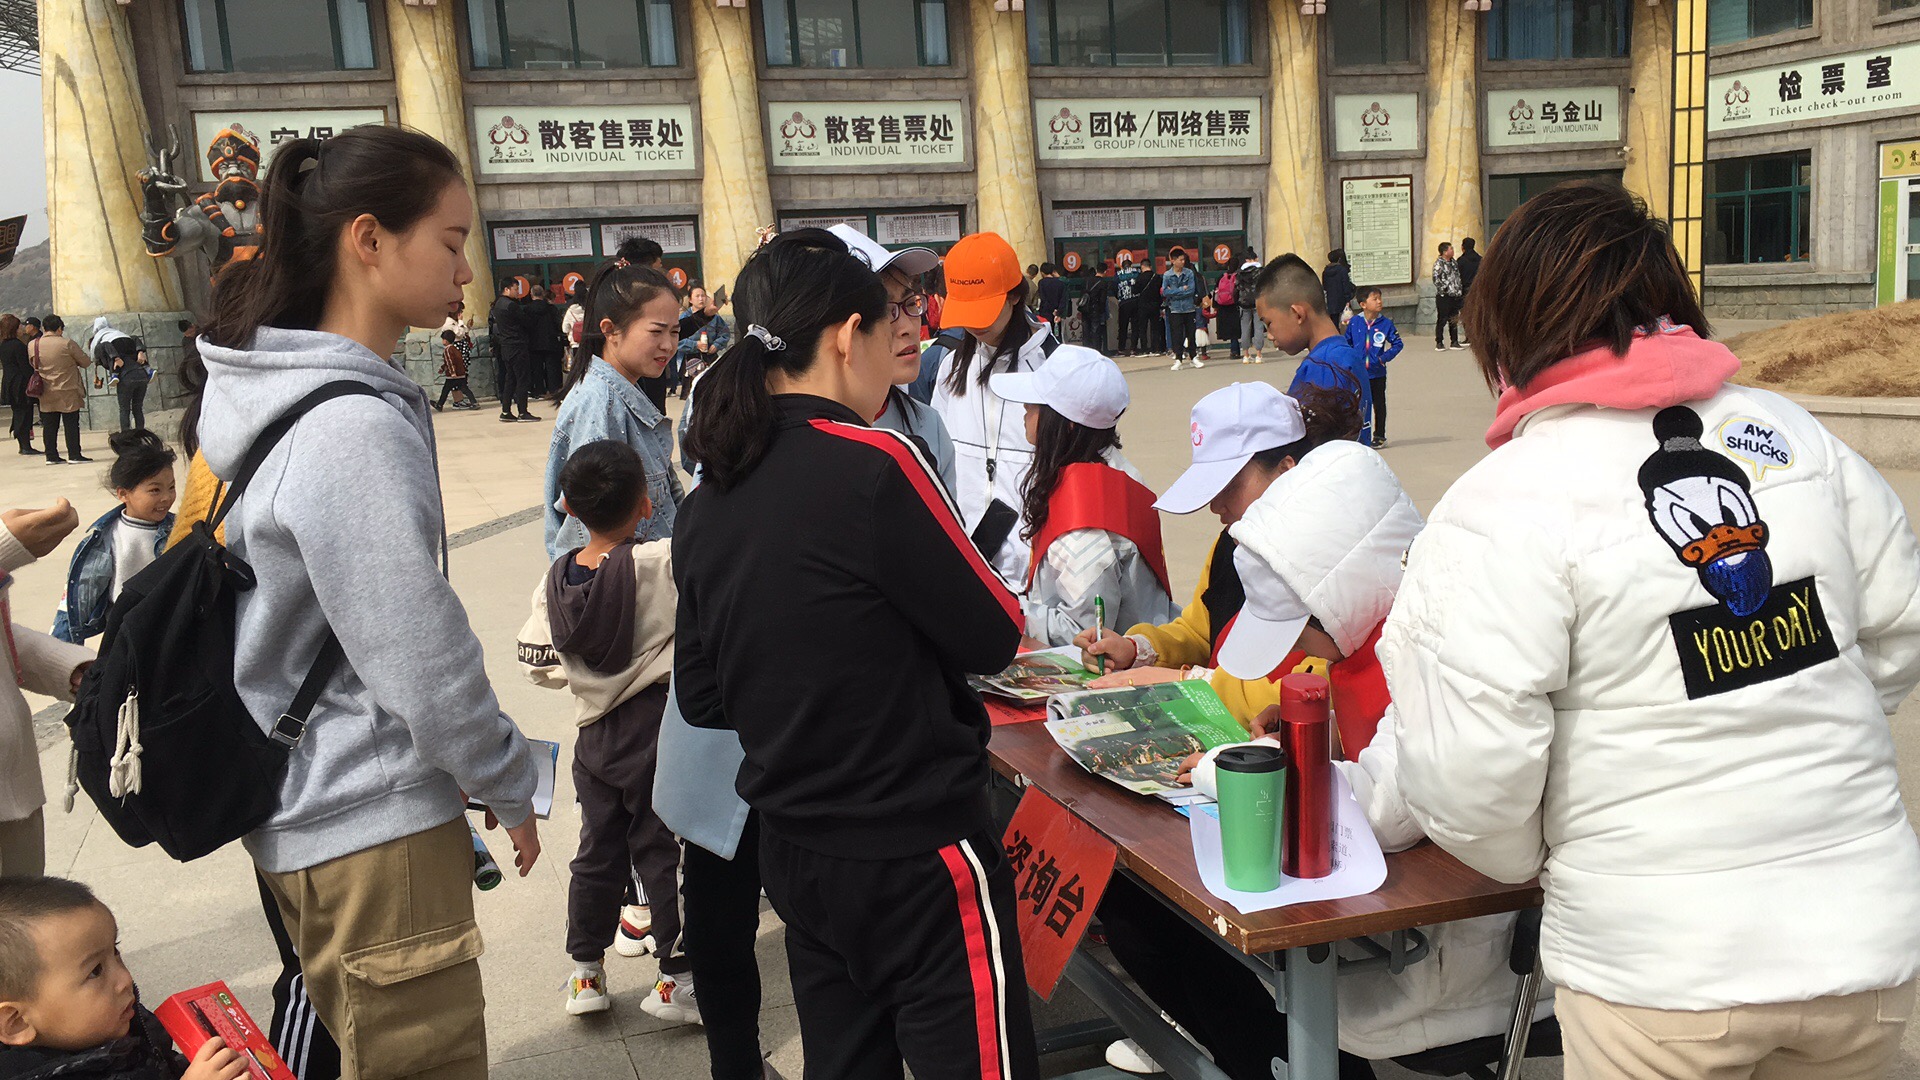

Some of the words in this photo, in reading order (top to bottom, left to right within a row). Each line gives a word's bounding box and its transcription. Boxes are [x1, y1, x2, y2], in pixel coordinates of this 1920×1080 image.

[1779, 55, 1892, 102] 检票室
[1540, 100, 1602, 124] 乌金山
[1769, 105, 1802, 116] Ticket
[1808, 97, 1866, 112] check-out
[1872, 92, 1902, 102] room
[538, 118, 684, 150] 散客售票处
[824, 114, 954, 144] 散客售票处
[1090, 109, 1251, 138] 团体/网络售票
[1542, 124, 1563, 133] WUJIN
[1564, 123, 1599, 133] MOUNTAIN
[830, 146, 902, 156] INDIVIDUAL
[910, 144, 954, 154] TICKET
[1094, 140, 1136, 149] GROUP
[1143, 139, 1185, 149] ONLINE
[1187, 138, 1247, 148] TICKETING
[546, 151, 626, 163] INDIVIDUAL
[637, 149, 684, 161] TICKET
[1067, 255, 1077, 269] 9
[1215, 247, 1229, 261] 12
[568, 276, 579, 291] 2
[672, 271, 683, 286] 4
[1726, 437, 1788, 465] SHUCKS
[1693, 619, 1773, 682] YOUR
[1006, 829, 1085, 939] 咨询台
